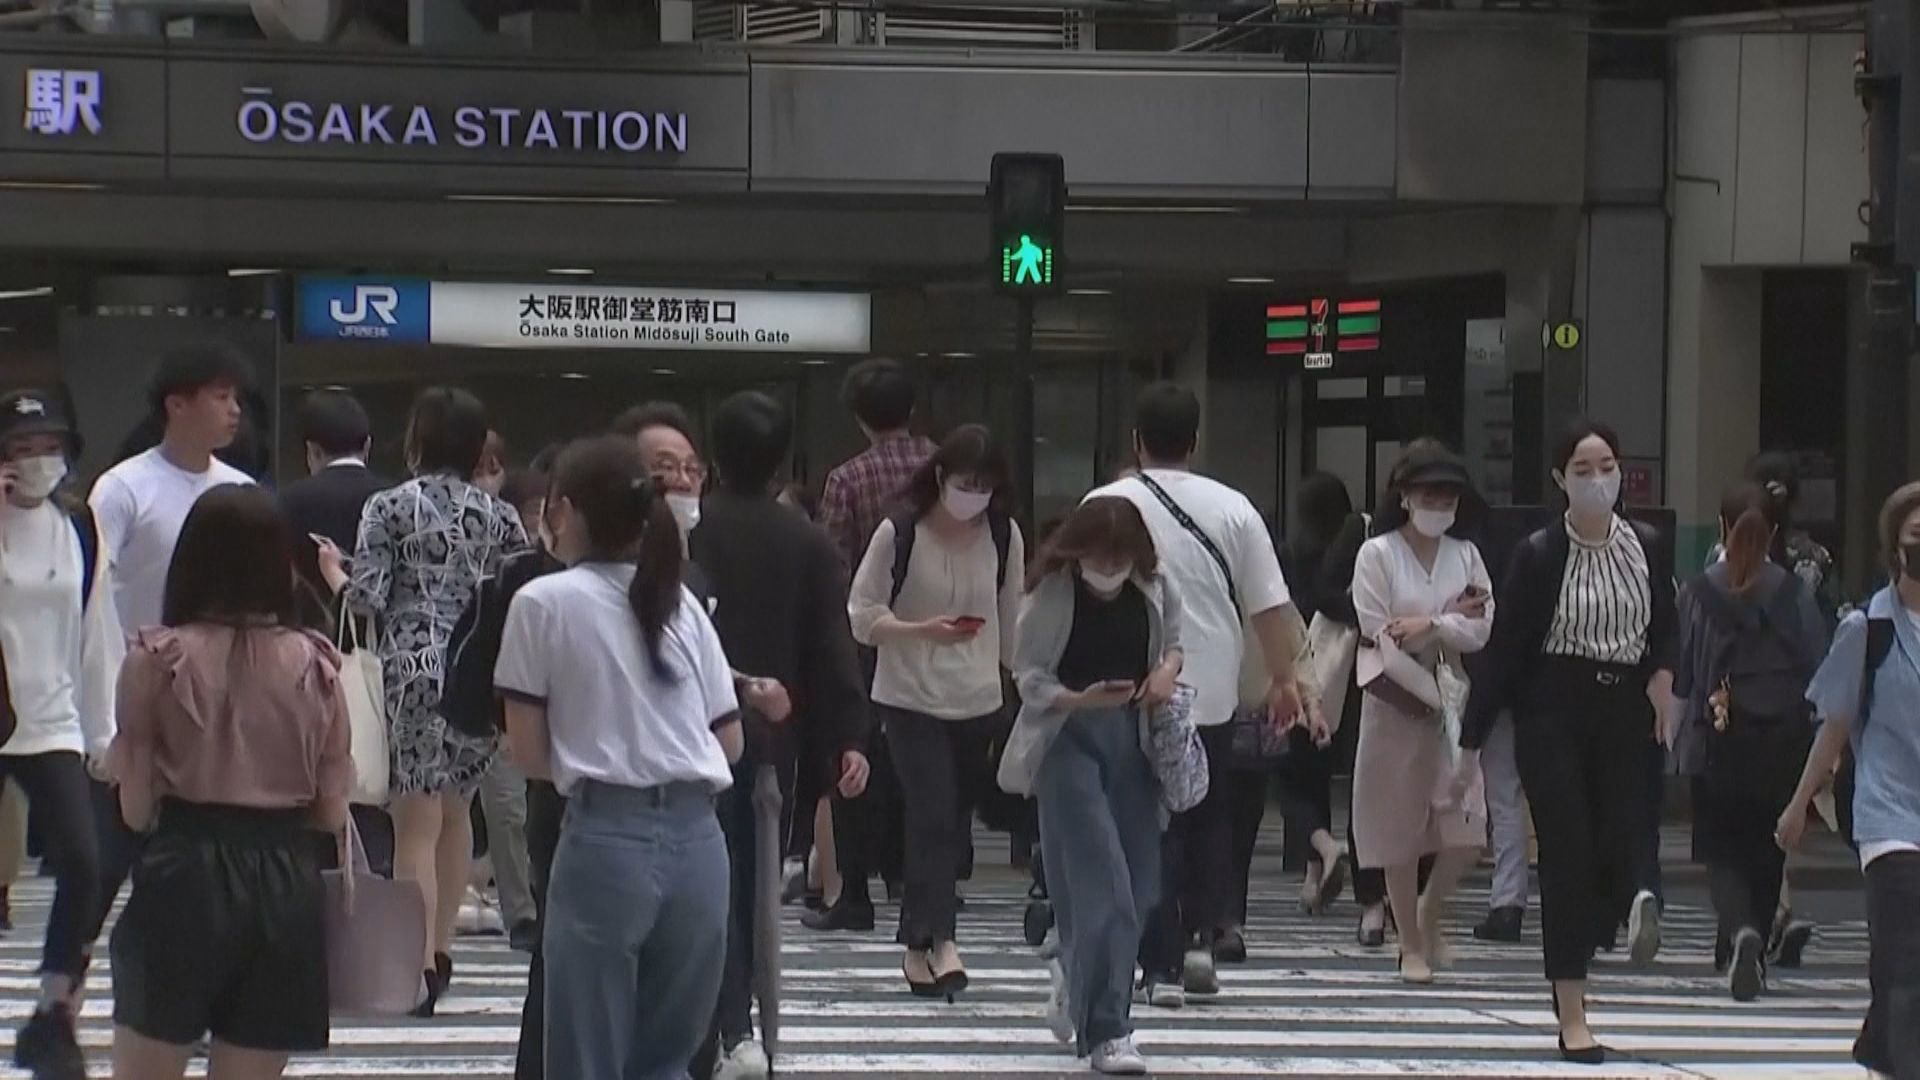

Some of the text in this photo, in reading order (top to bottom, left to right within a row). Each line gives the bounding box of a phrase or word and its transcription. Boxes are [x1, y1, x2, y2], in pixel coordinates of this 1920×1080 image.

[25, 69, 101, 135] 駅
[237, 87, 688, 153] ŌSAKA STATION
[329, 285, 398, 324] JR
[519, 294, 737, 324] 大阪駅御堂筋南口
[573, 324, 629, 340] Station
[705, 327, 749, 343] South
[755, 329, 790, 343] Gate
